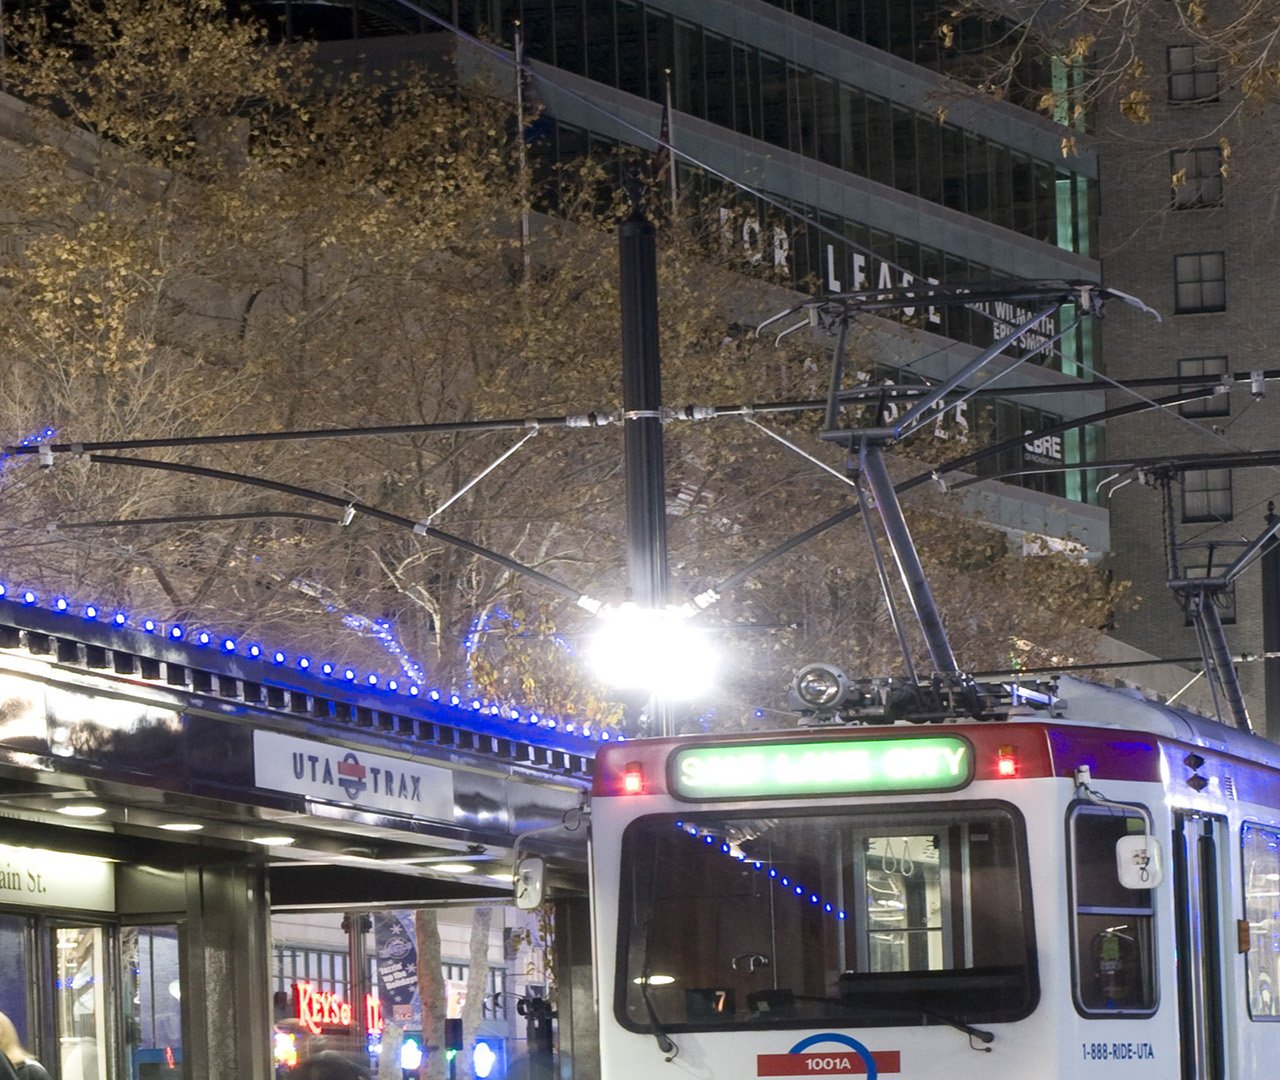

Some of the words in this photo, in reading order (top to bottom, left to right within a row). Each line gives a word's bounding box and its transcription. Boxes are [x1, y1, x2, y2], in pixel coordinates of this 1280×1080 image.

[827, 244, 941, 325] LEASE
[1024, 429, 1062, 459] CBRE
[292, 752, 334, 786] UTA
[370, 767, 421, 802] TRAX
[26, 865, 47, 894] St.
[296, 982, 341, 1035] KEYS
[805, 1057, 852, 1071] 1001A
[1082, 1043, 1155, 1060] 1-888-RIDE-UTA
